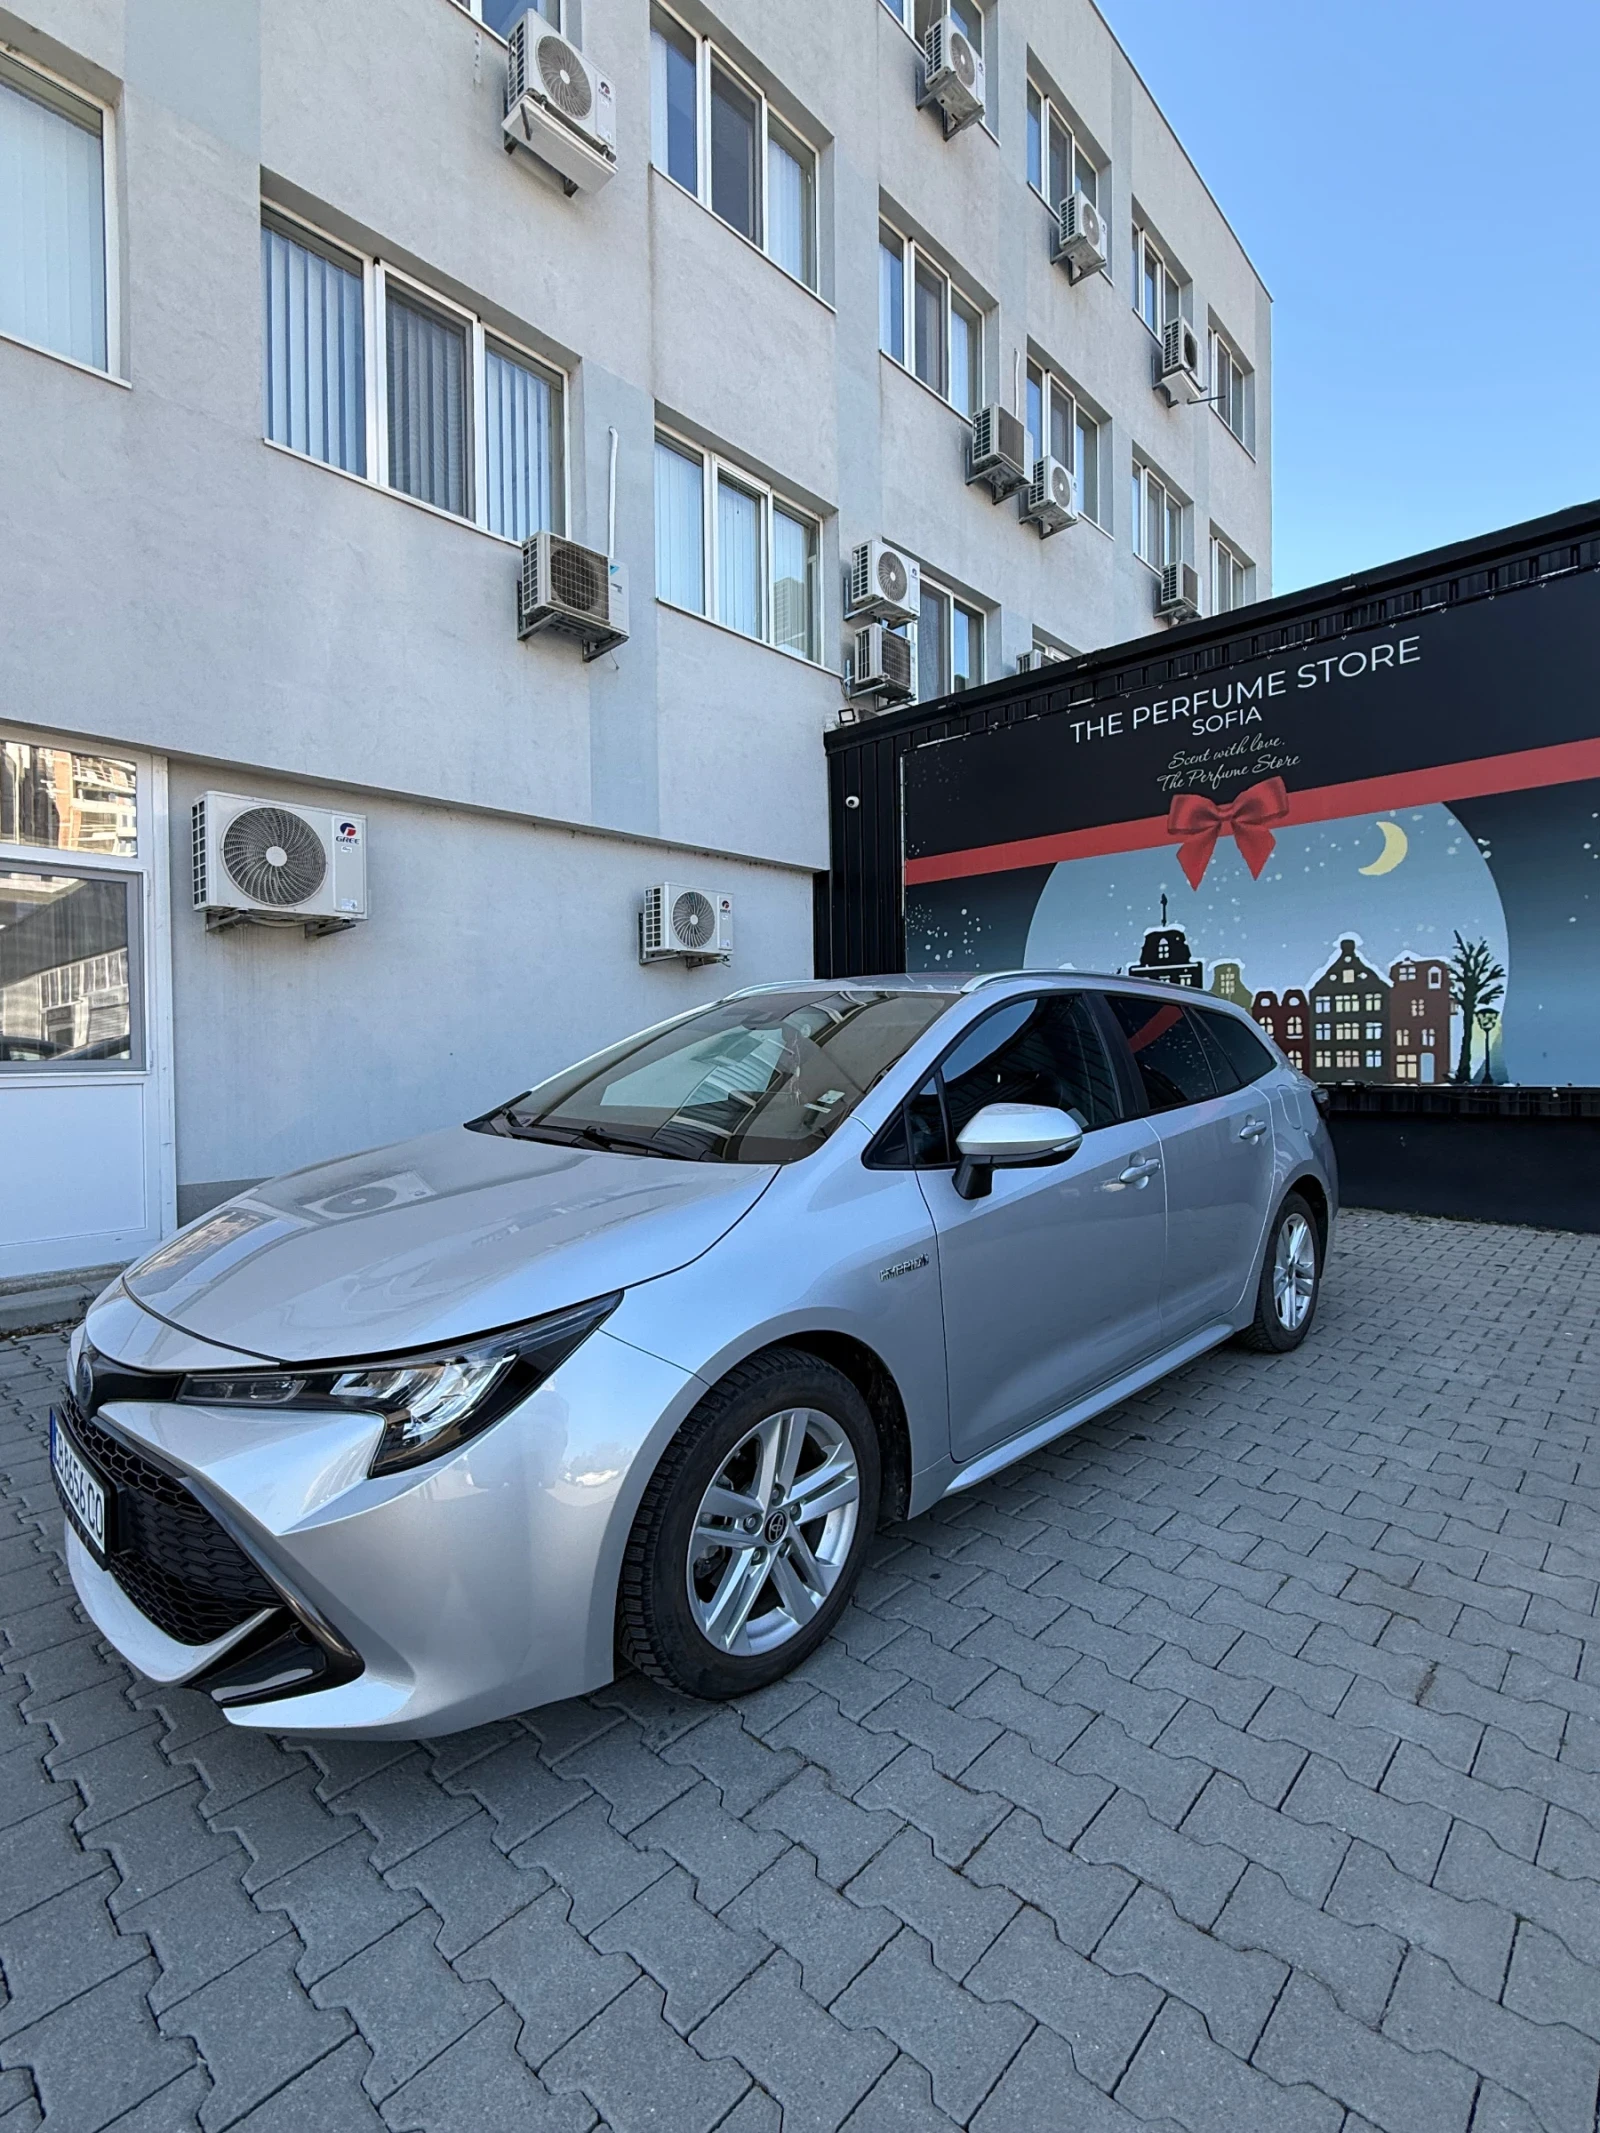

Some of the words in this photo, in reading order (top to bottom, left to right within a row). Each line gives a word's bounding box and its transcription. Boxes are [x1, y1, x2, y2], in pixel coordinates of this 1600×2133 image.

[1070, 712, 1123, 743] THE
[1132, 670, 1286, 730] PERFUME
[1297, 635, 1421, 689] STORE
[1191, 706, 1262, 736] SOFIA
[1168, 748, 1211, 770] Scent
[1213, 735, 1247, 761] with
[1250, 732, 1286, 752] love.
[1156, 771, 1185, 791] The
[1186, 763, 1249, 790] Perfume
[1251, 753, 1301, 774] Store
[336, 836, 360, 844] GREE
